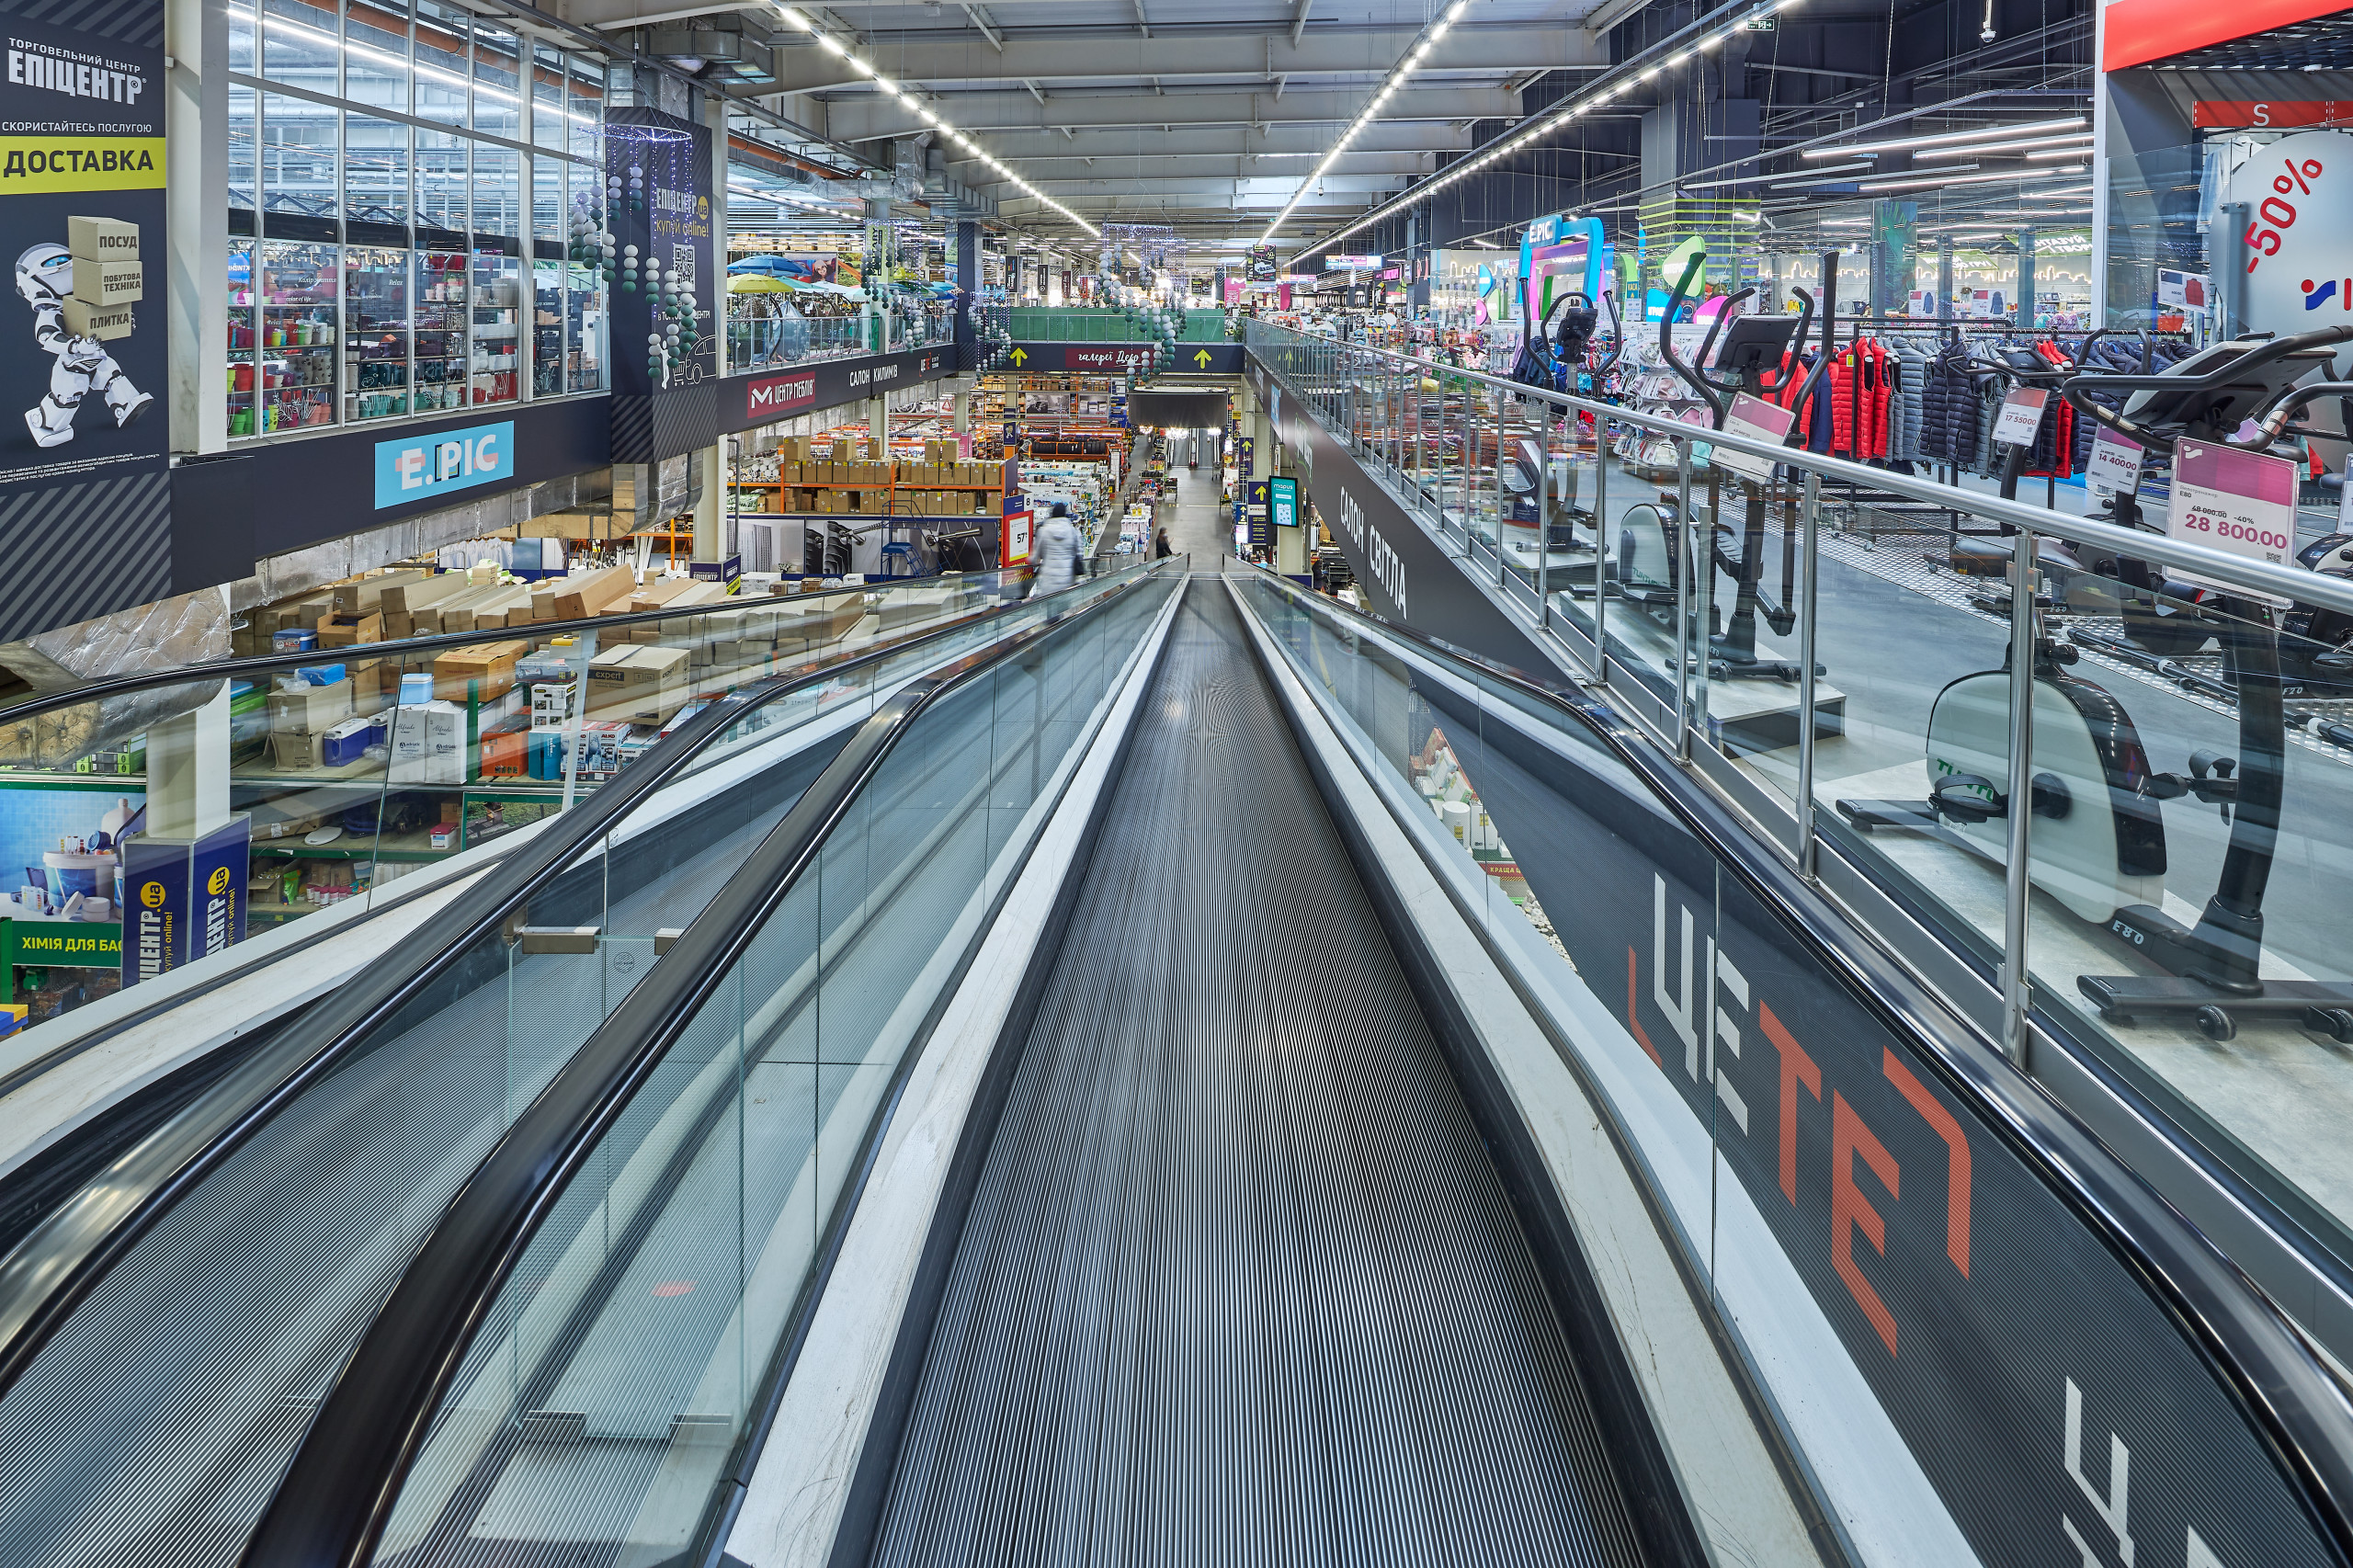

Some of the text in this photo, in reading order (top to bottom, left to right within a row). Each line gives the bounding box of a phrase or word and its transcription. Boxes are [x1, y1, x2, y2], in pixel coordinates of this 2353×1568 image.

[8, 37, 141, 74] ТОРГОВЕЛЬНИЙ ЦЕНТР
[8, 49, 142, 106] ЕПІЦЕНТР
[2, 119, 152, 133] СКОРИСТАЙТЕСЬ ПОСЛУГОЮ
[2253, 103, 2269, 127] S
[3, 149, 154, 177] ДОСТАВКА
[2244, 158, 2323, 274] -50%
[99, 235, 138, 249] ПОСУД
[1529, 221, 1553, 244] E.PIC
[104, 272, 141, 283] ПОБУТОВА
[104, 280, 142, 292] ТЕХНІКА
[90, 312, 130, 330] ПЛИТКА
[849, 364, 898, 387] САЛОН КИЛИМІВ
[775, 380, 813, 405] ЦЕНТР МЕБЛІВ
[401, 434, 497, 491] E.PIC
[2098, 453, 2137, 471] 14 400.00
[2185, 514, 2288, 550] 28 800.00
[2234, 516, 2255, 525] -40%
[1339, 485, 1407, 620] САЛОН СВІТЛА
[596, 671, 622, 680] expert
[227, 888, 236, 920] online!
[139, 884, 164, 983] ІЦЕНТР.ua
[164, 912, 173, 944] online!
[2112, 919, 2144, 945] E80
[22, 937, 63, 950] ХІМІЯ
[64, 937, 96, 952] ДЛЯ
